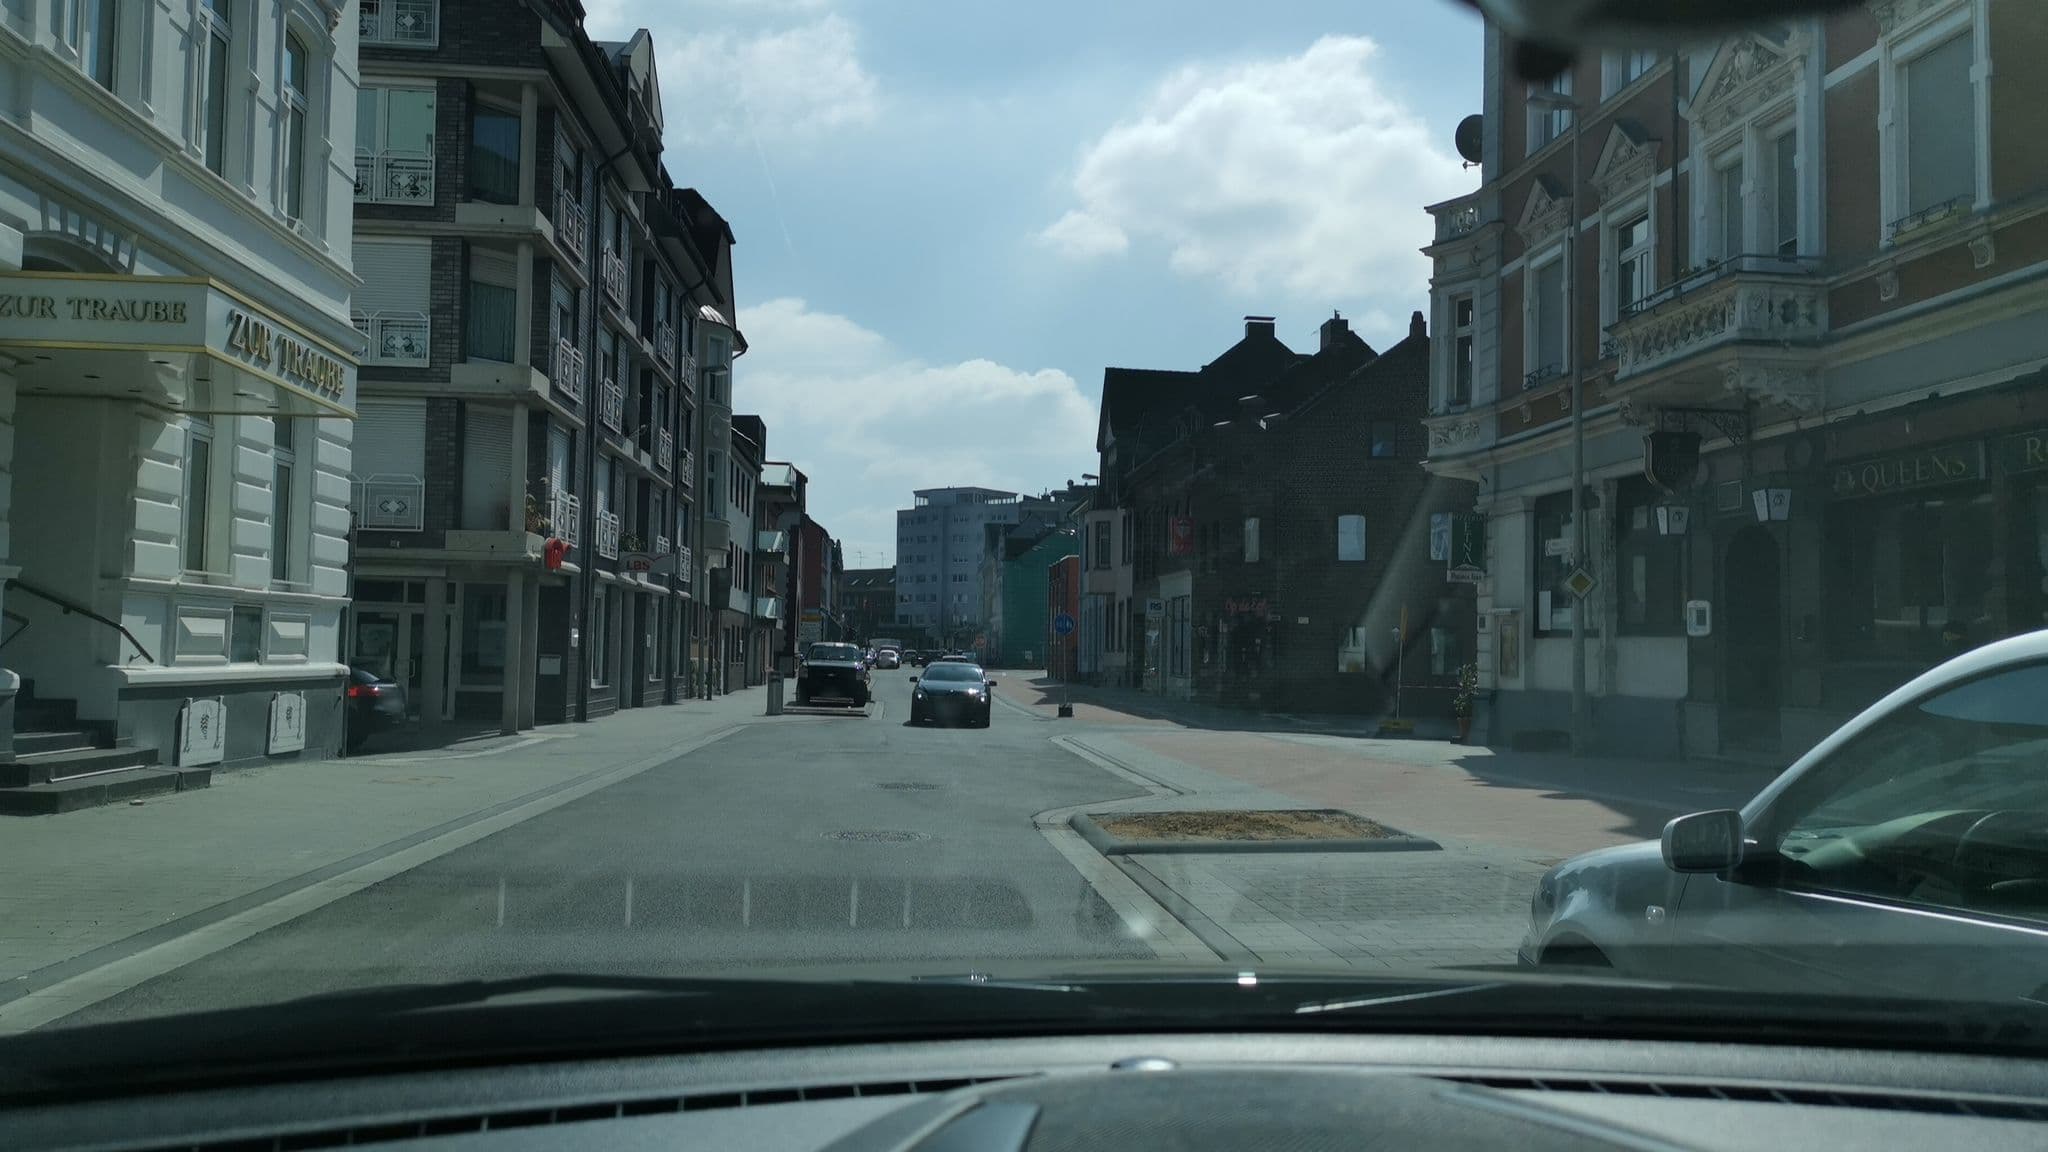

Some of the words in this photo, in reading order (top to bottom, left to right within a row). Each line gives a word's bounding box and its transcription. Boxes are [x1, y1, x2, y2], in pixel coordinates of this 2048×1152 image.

[0, 294, 57, 319] ZUR
[66, 296, 187, 323] TRAUBE
[231, 310, 273, 364] ZUR
[279, 336, 345, 395] TRAUBE
[2024, 437, 2048, 464] R
[1862, 455, 1968, 493] QUEENS
